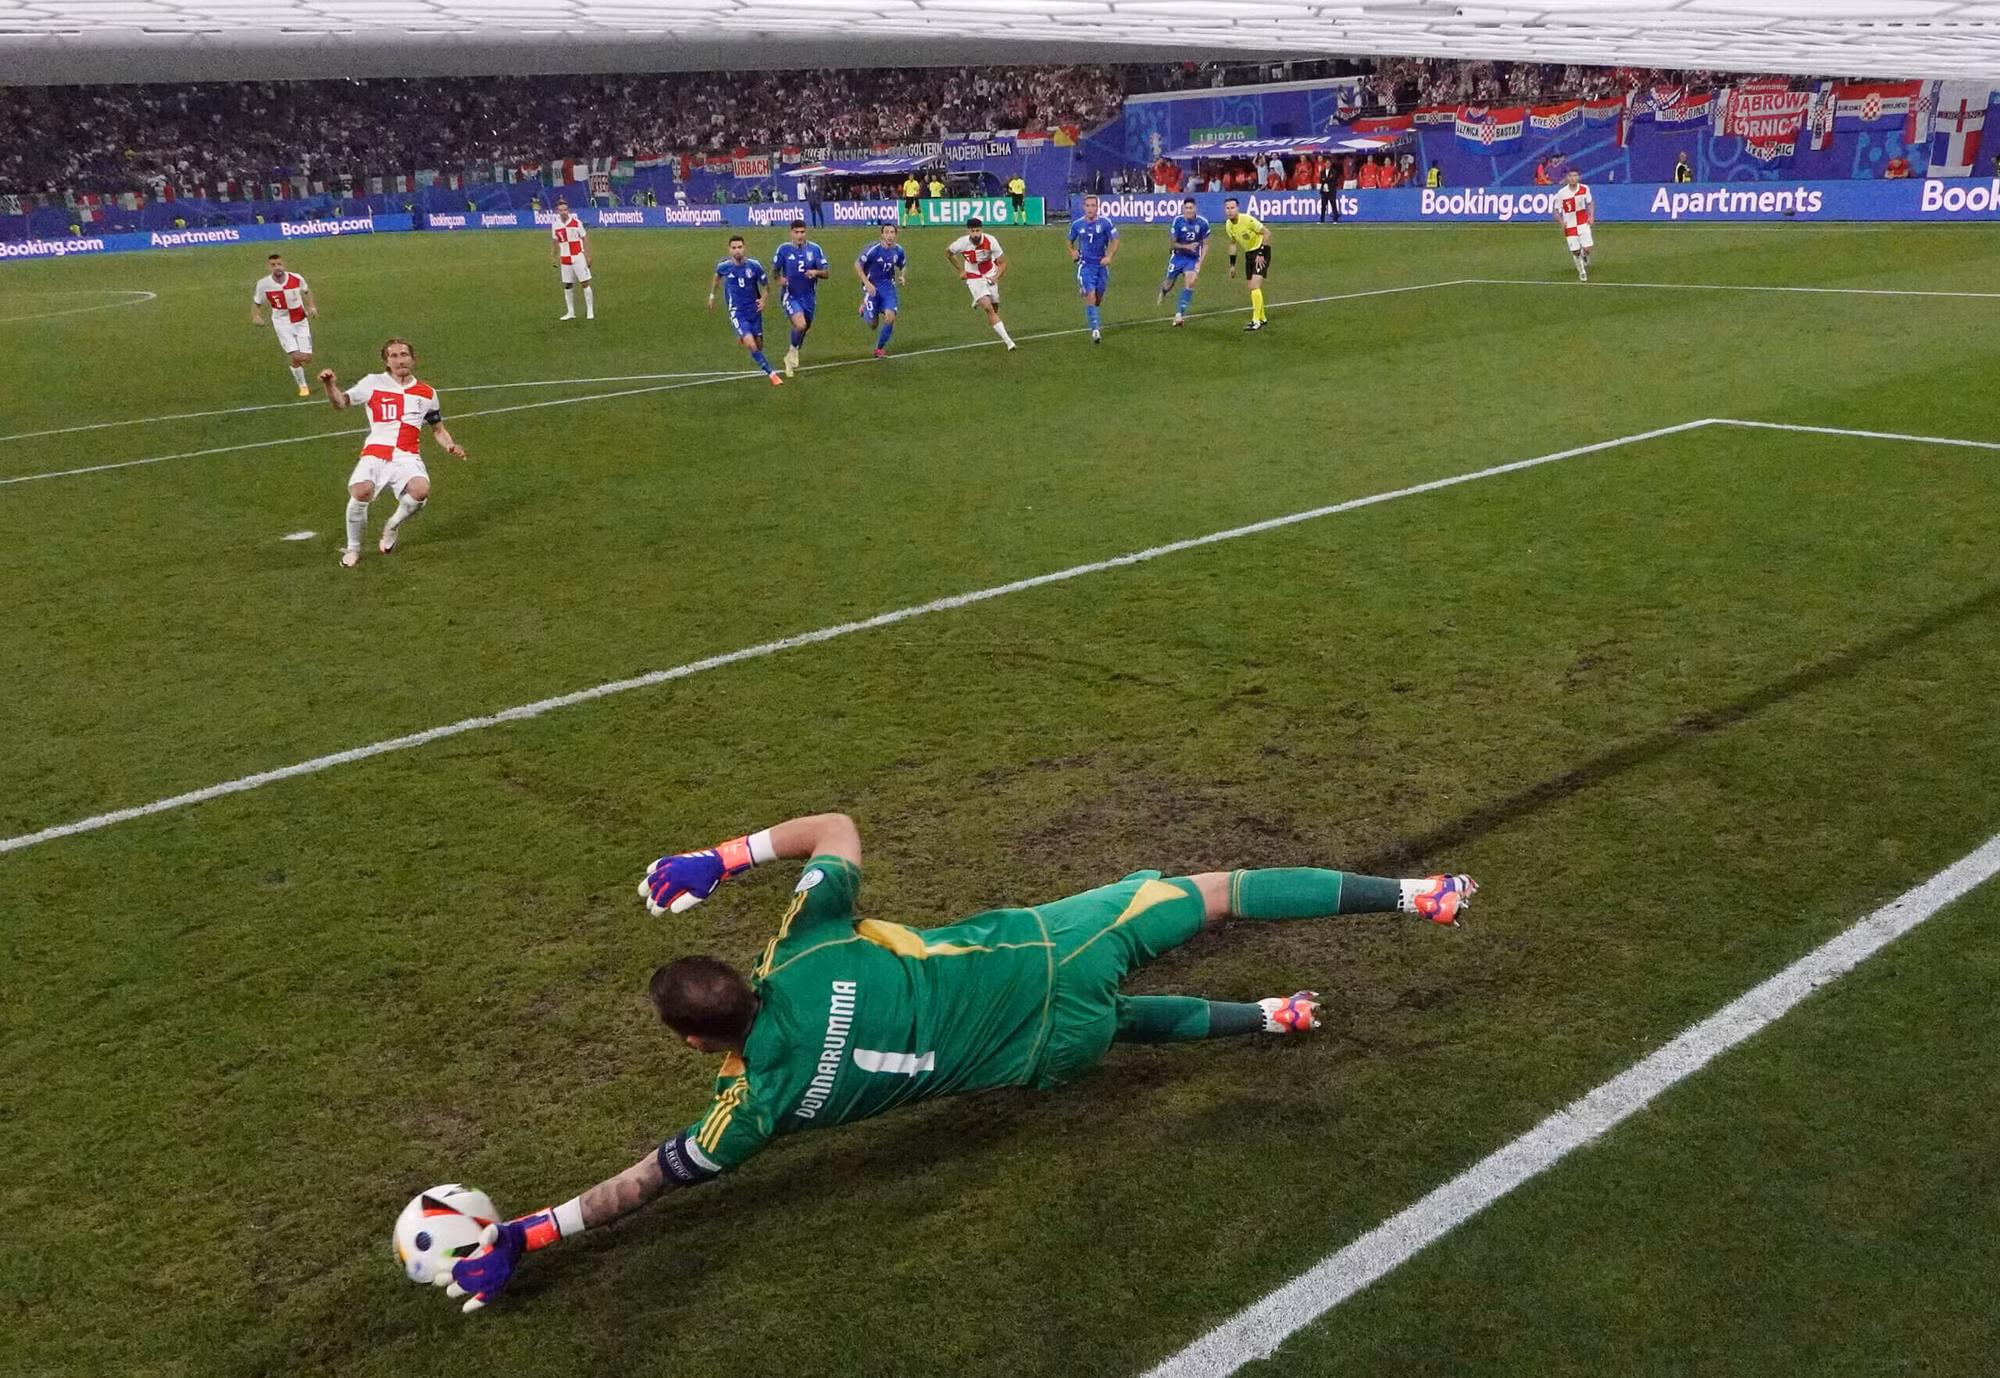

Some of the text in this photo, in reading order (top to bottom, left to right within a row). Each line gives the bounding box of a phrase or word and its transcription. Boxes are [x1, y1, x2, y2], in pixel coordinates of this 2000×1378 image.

[735, 159, 770, 176] URBACH
[598, 210, 643, 226] Apartments
[666, 206, 721, 225] Booking.com
[748, 205, 804, 225] Apartments
[1650, 187, 1822, 219] Apartments
[929, 200, 1007, 222] LEIPZIG
[151, 229, 239, 247] Apartments
[281, 218, 373, 236] Booking.com
[1088, 233, 1094, 243] 7
[1186, 232, 1196, 240] 23
[798, 260, 805, 272] 2
[738, 277, 745, 288] 8
[381, 404, 397, 420] 10
[795, 981, 857, 1119] DONNARUMMA
[853, 1048, 935, 1077] 1
